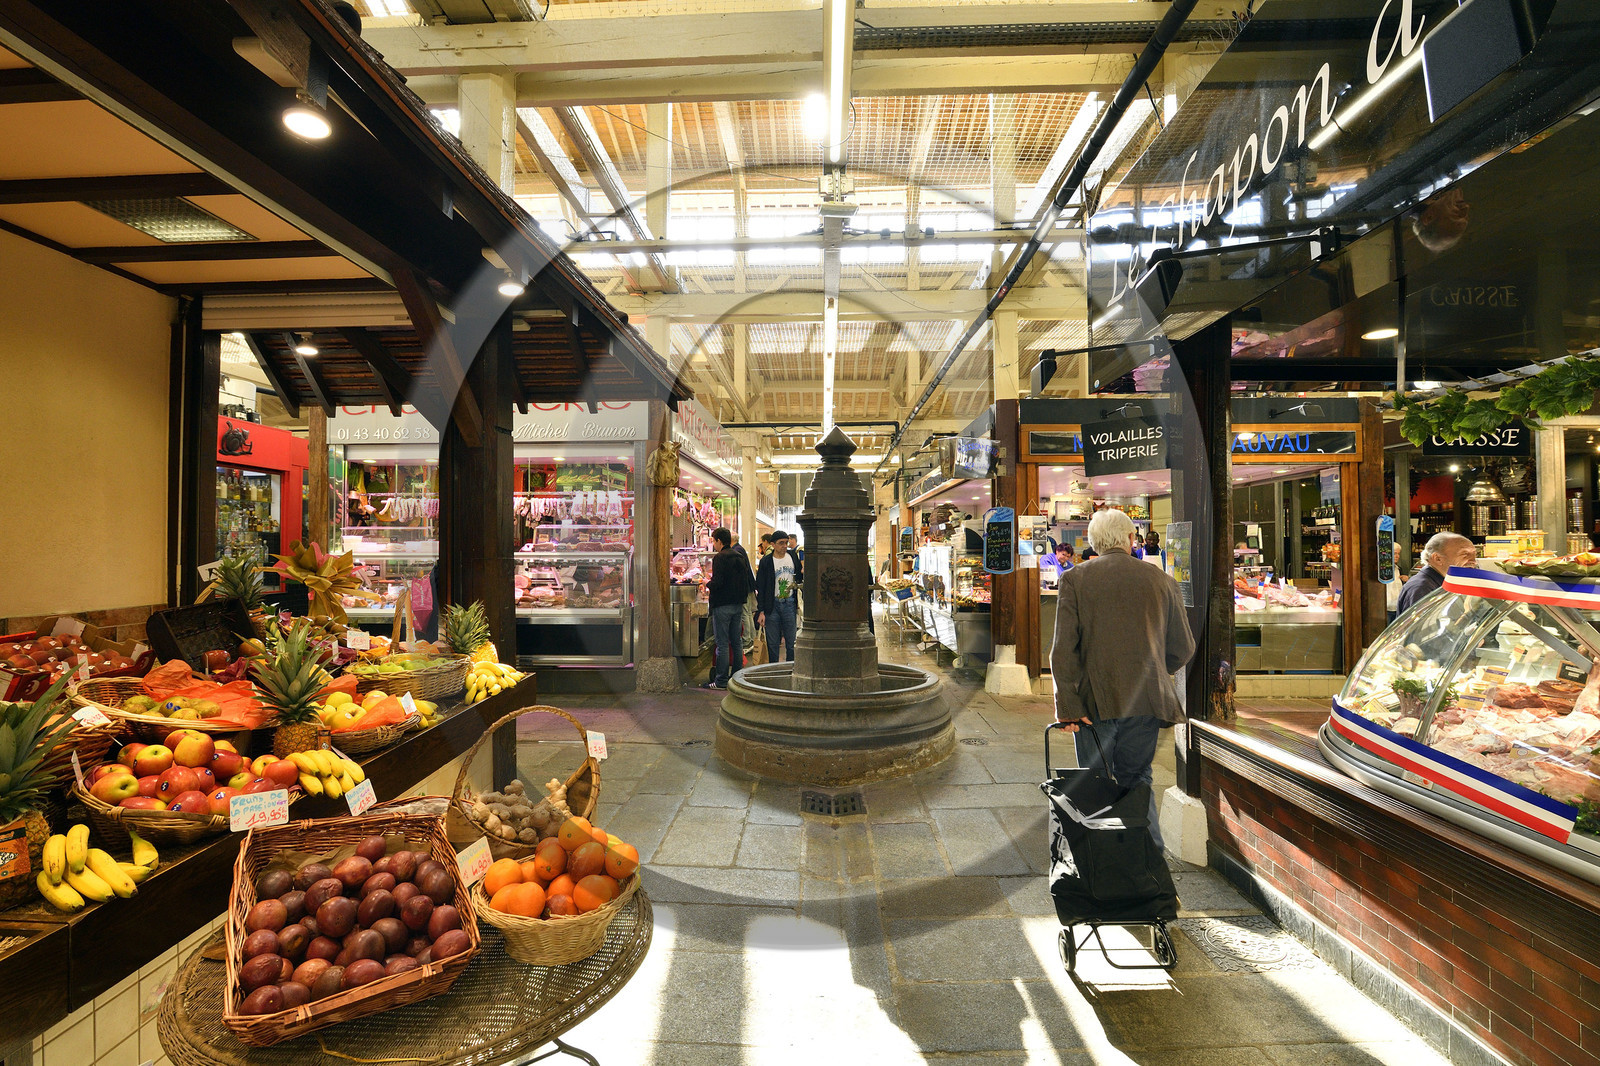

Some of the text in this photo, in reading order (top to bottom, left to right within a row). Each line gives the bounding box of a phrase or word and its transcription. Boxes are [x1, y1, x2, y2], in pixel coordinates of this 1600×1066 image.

[337, 426, 431, 440] 01 43 40 62 58
[512, 421, 636, 439] Michel Brunon
[1090, 426, 1163, 446] VOLAILLES
[1231, 433, 1310, 452] AUVAU
[1098, 443, 1159, 461] TRIPERIE
